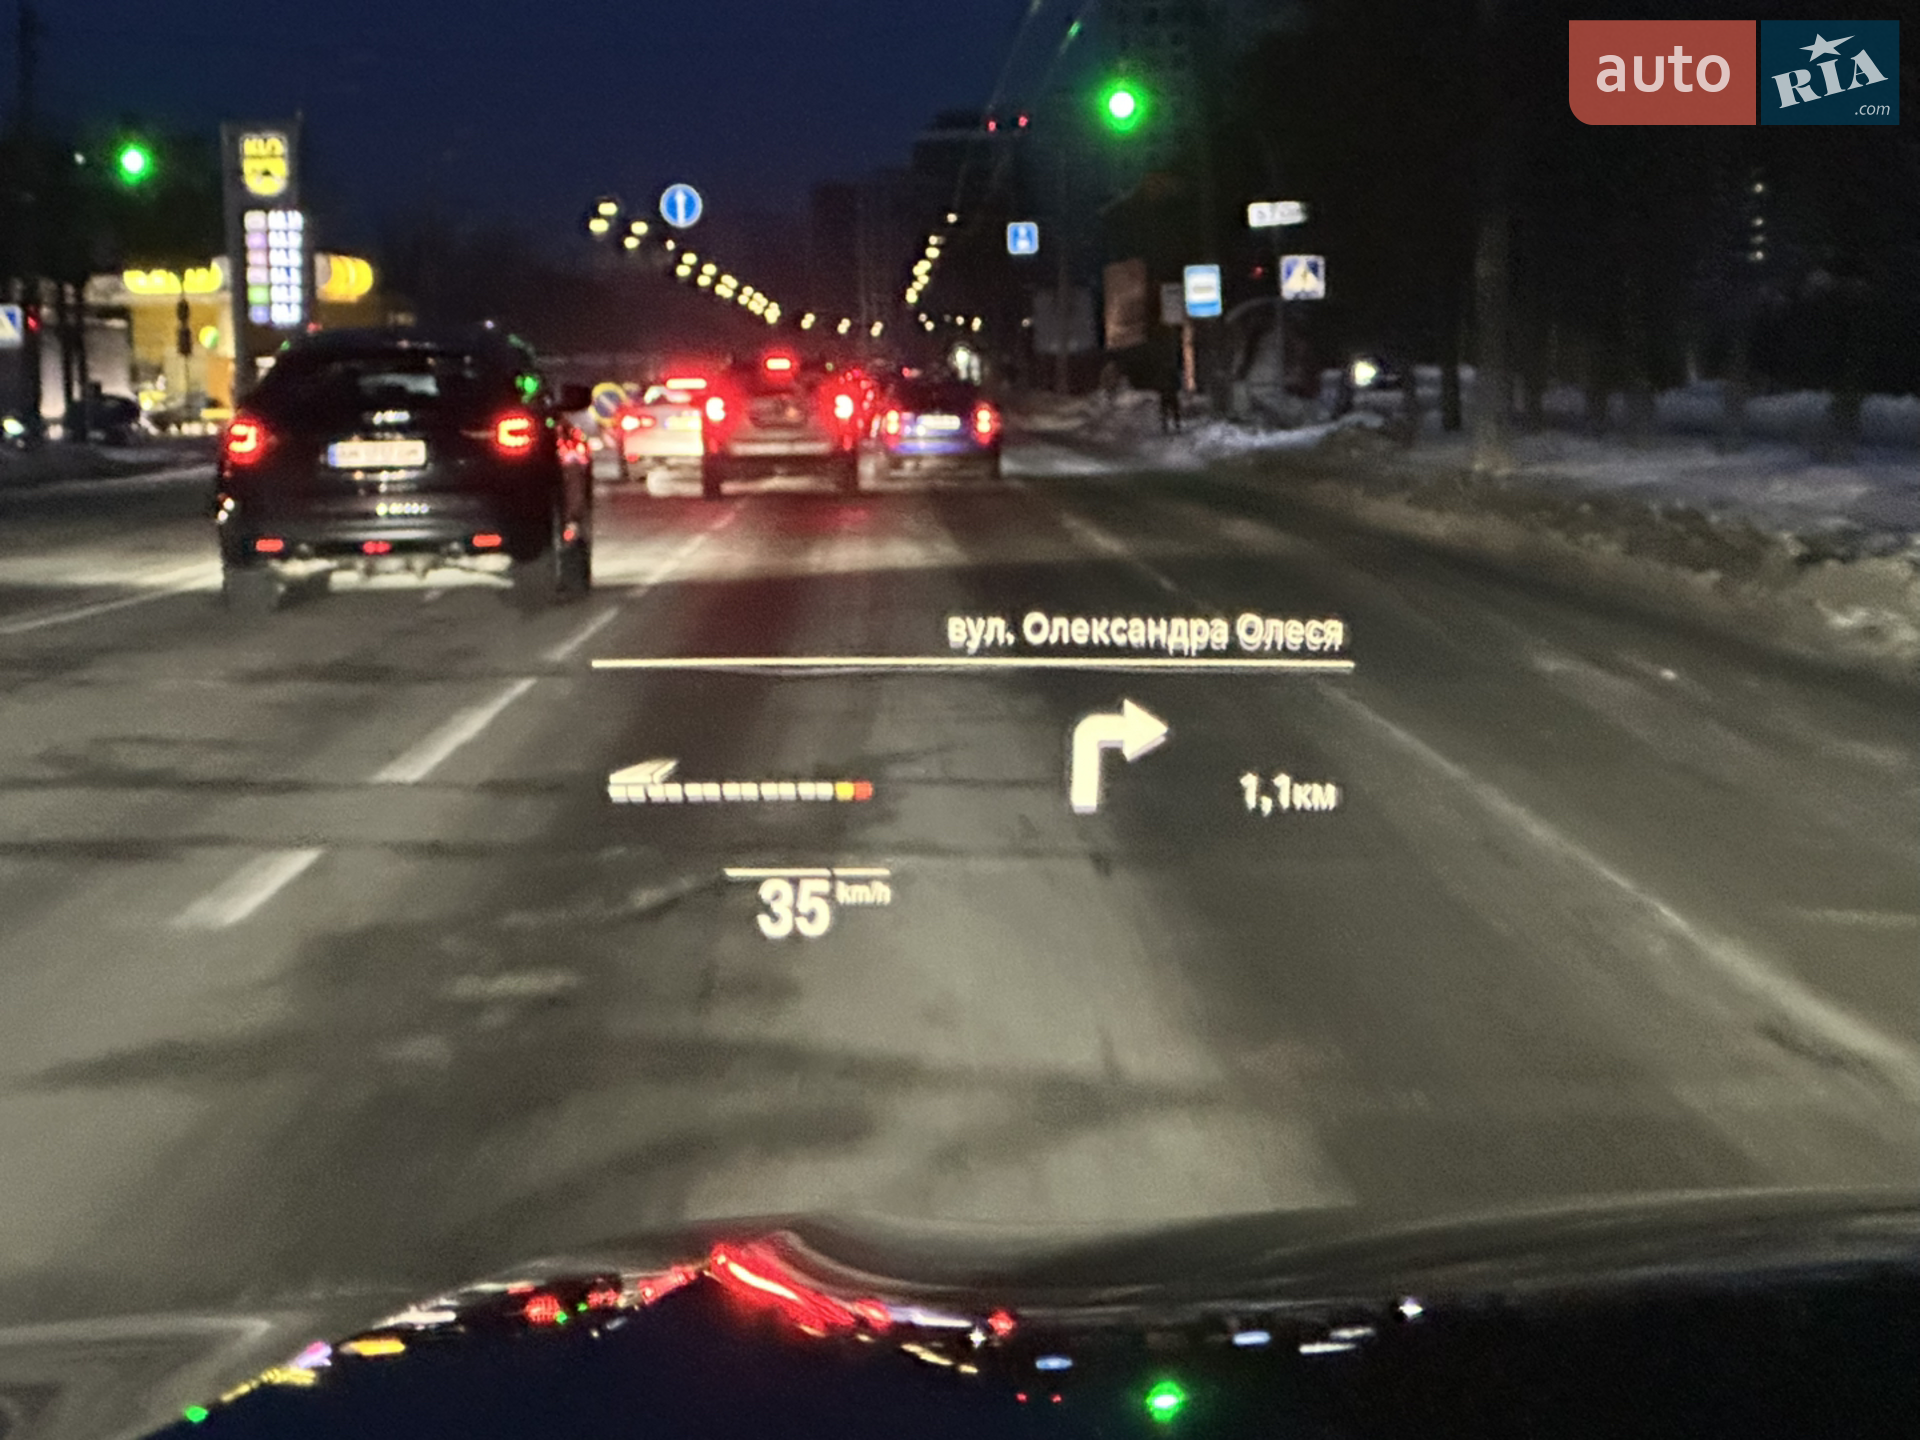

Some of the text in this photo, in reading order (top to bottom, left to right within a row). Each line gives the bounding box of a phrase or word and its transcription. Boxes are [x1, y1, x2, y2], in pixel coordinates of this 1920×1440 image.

[947, 612, 1344, 656] вул. Олександра Олеся
[756, 878, 892, 940] 35 km/h
